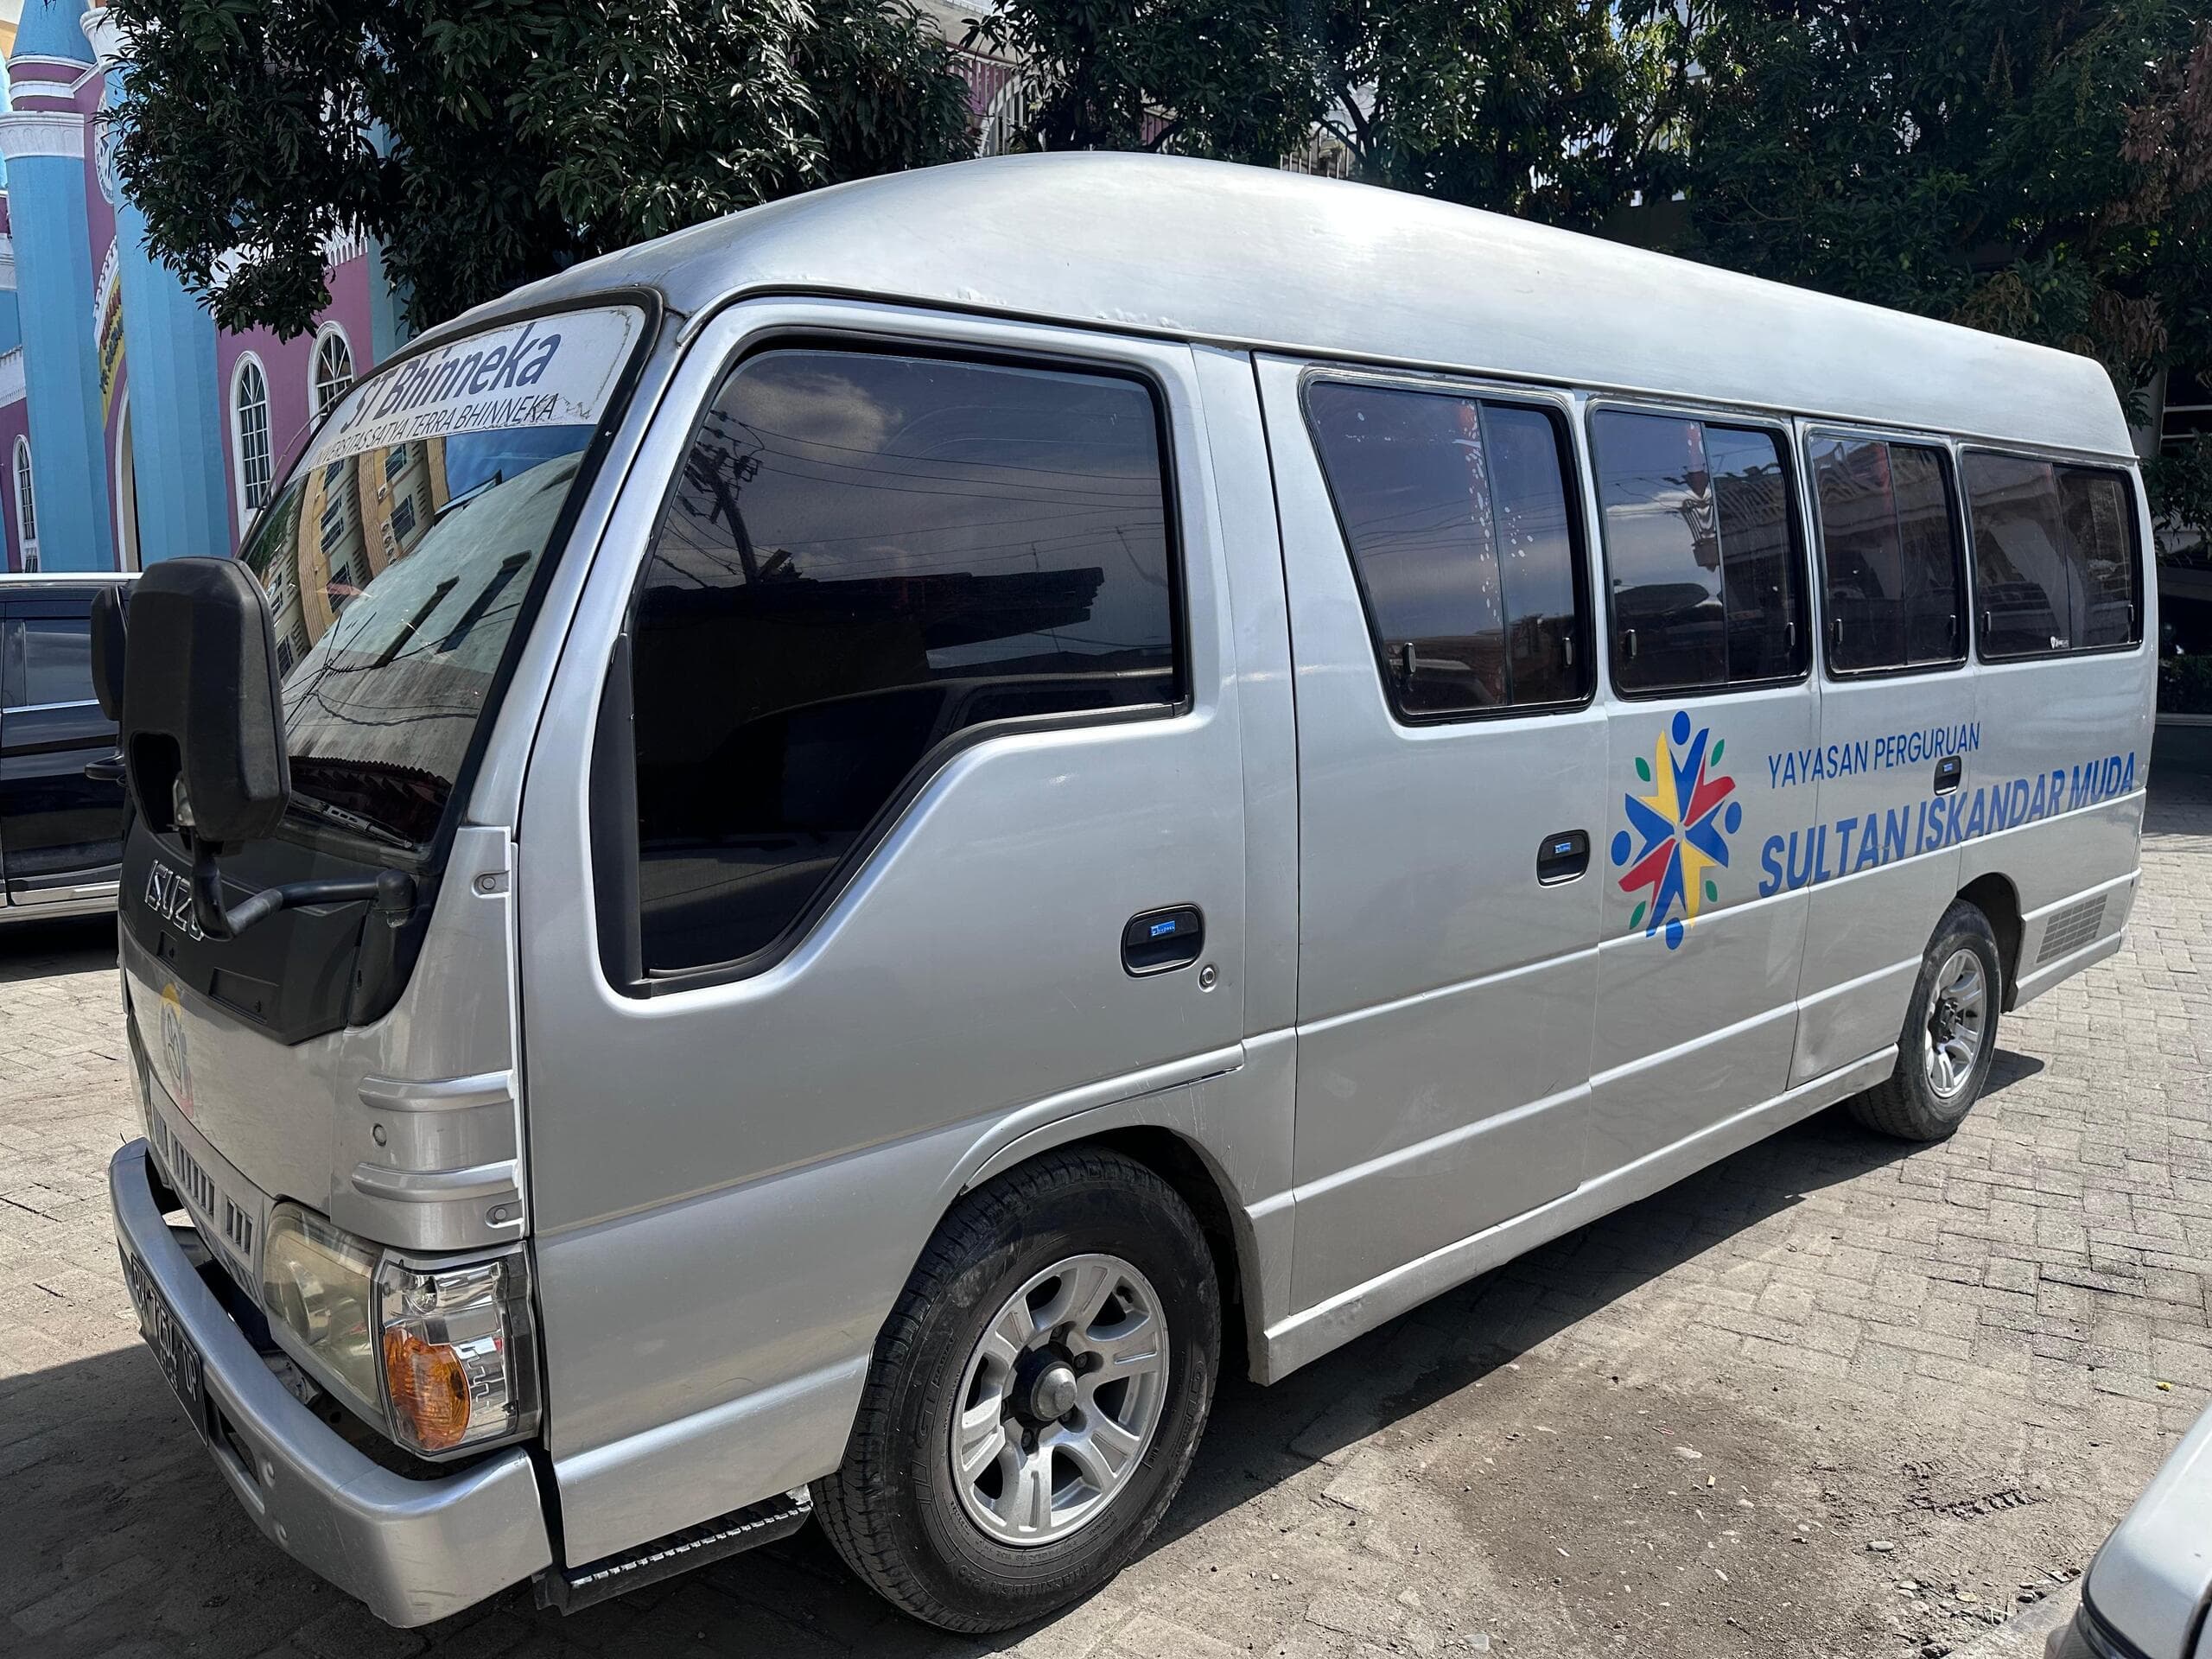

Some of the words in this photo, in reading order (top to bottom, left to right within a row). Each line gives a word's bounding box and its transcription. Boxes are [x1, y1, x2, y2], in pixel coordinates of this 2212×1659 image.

[372, 321, 562, 421] Bhinneka
[406, 408, 456, 438] TERRA
[454, 393, 559, 429] BHINNEKA
[1768, 740, 1869, 790] YAYASAN
[1873, 721, 1981, 771] PERGURUAN
[1758, 804, 1910, 899] SULTAN
[1914, 768, 2066, 855] ISKANDAR
[2067, 751, 2136, 816] MUDA
